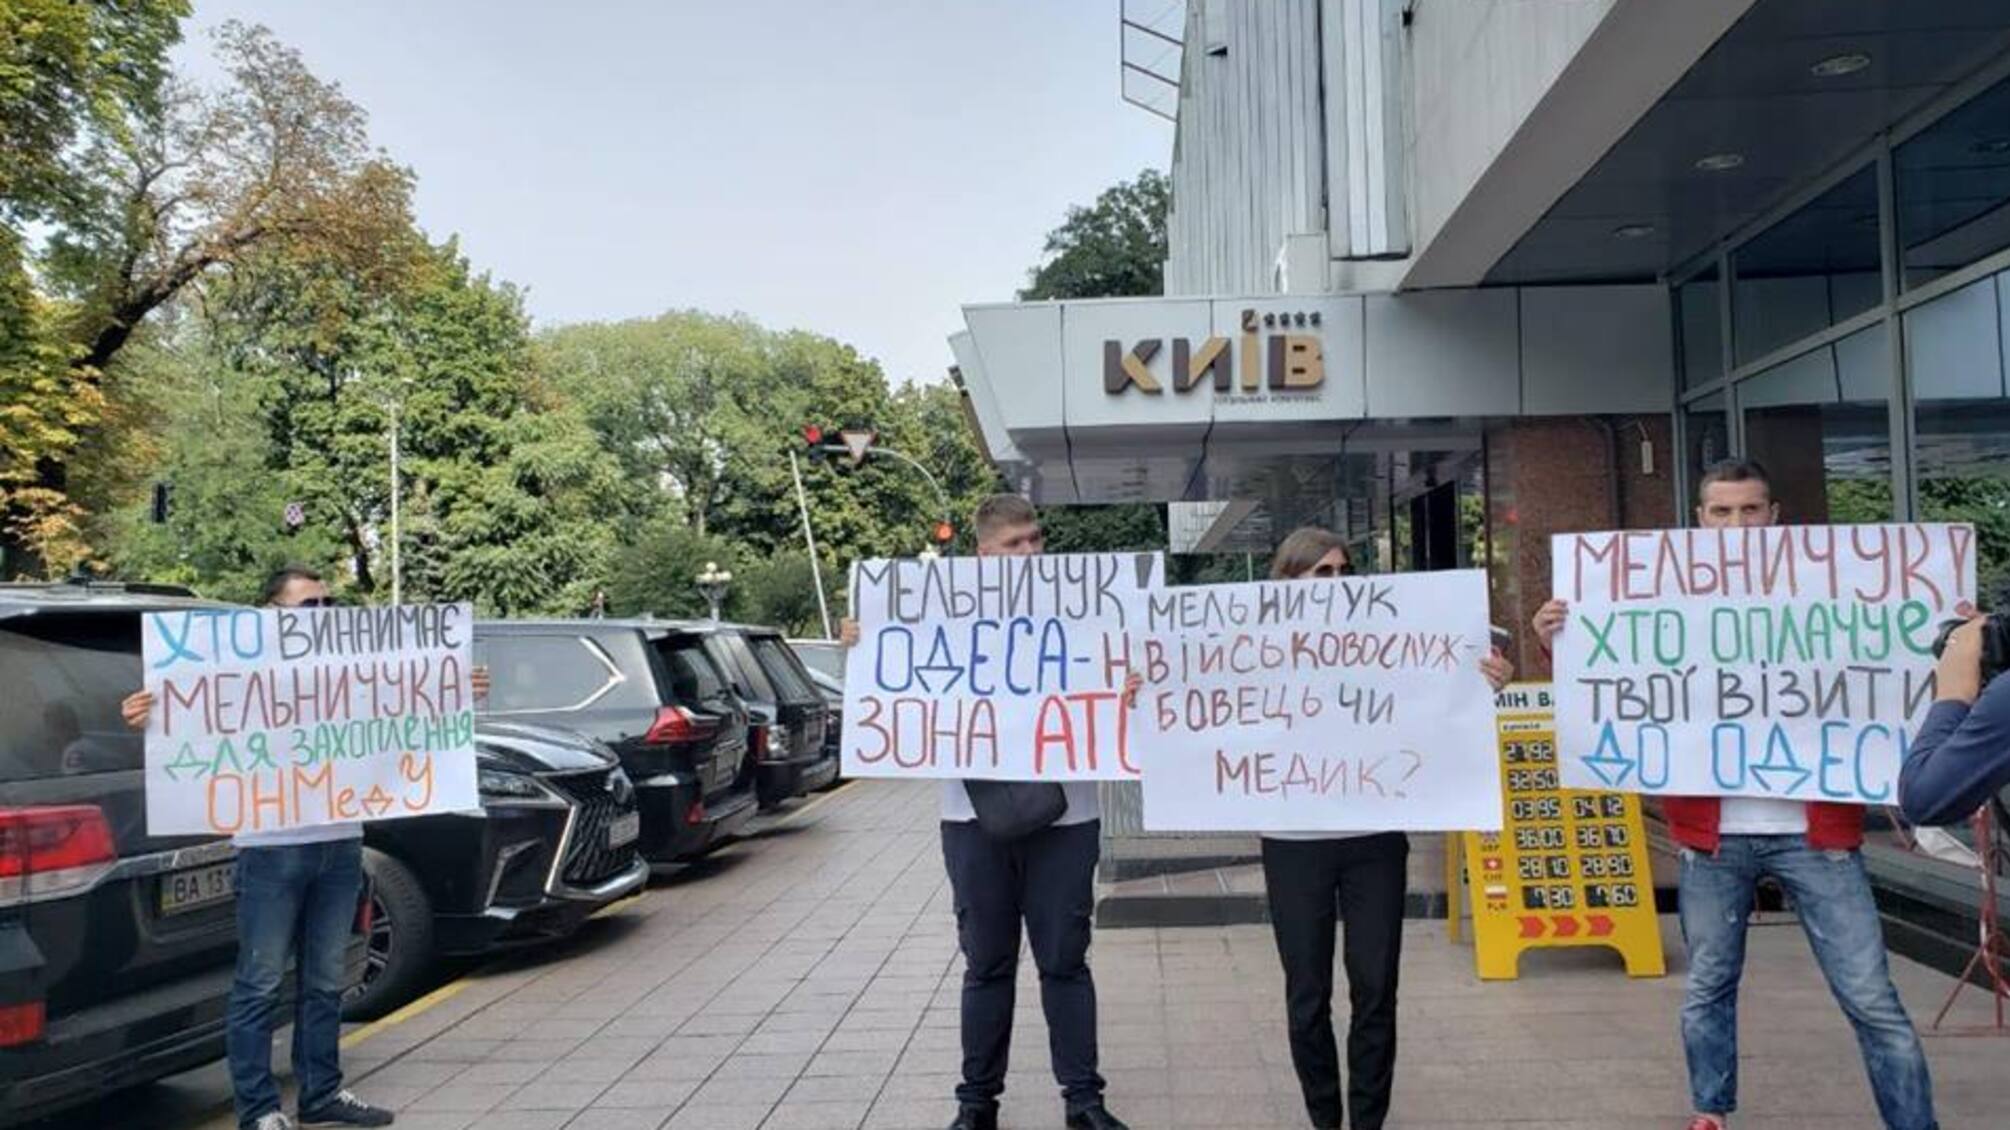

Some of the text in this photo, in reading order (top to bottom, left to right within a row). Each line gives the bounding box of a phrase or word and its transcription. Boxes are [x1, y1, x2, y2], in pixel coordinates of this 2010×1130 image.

[1149, 582, 1398, 632] МЕЛЬНИЧУК
[153, 609, 264, 669] ХТО
[1145, 632, 1480, 684] ВІЙСЬКОВОСЛУЖ-
[1580, 609, 1686, 666] ХТО
[163, 655, 462, 736] МЕЛЬНИЧУКА
[1156, 683, 1394, 731] БОВЕЦЬ ЧИ
[1578, 660, 1938, 723] ТВОЇ ВІЗИТИ
[165, 732, 277, 781] ДЛЯ
[857, 696, 998, 768] ЗОНА
[1580, 719, 1908, 800] ДО ОДЕС
[1216, 750, 1421, 799] МЕДИК?
